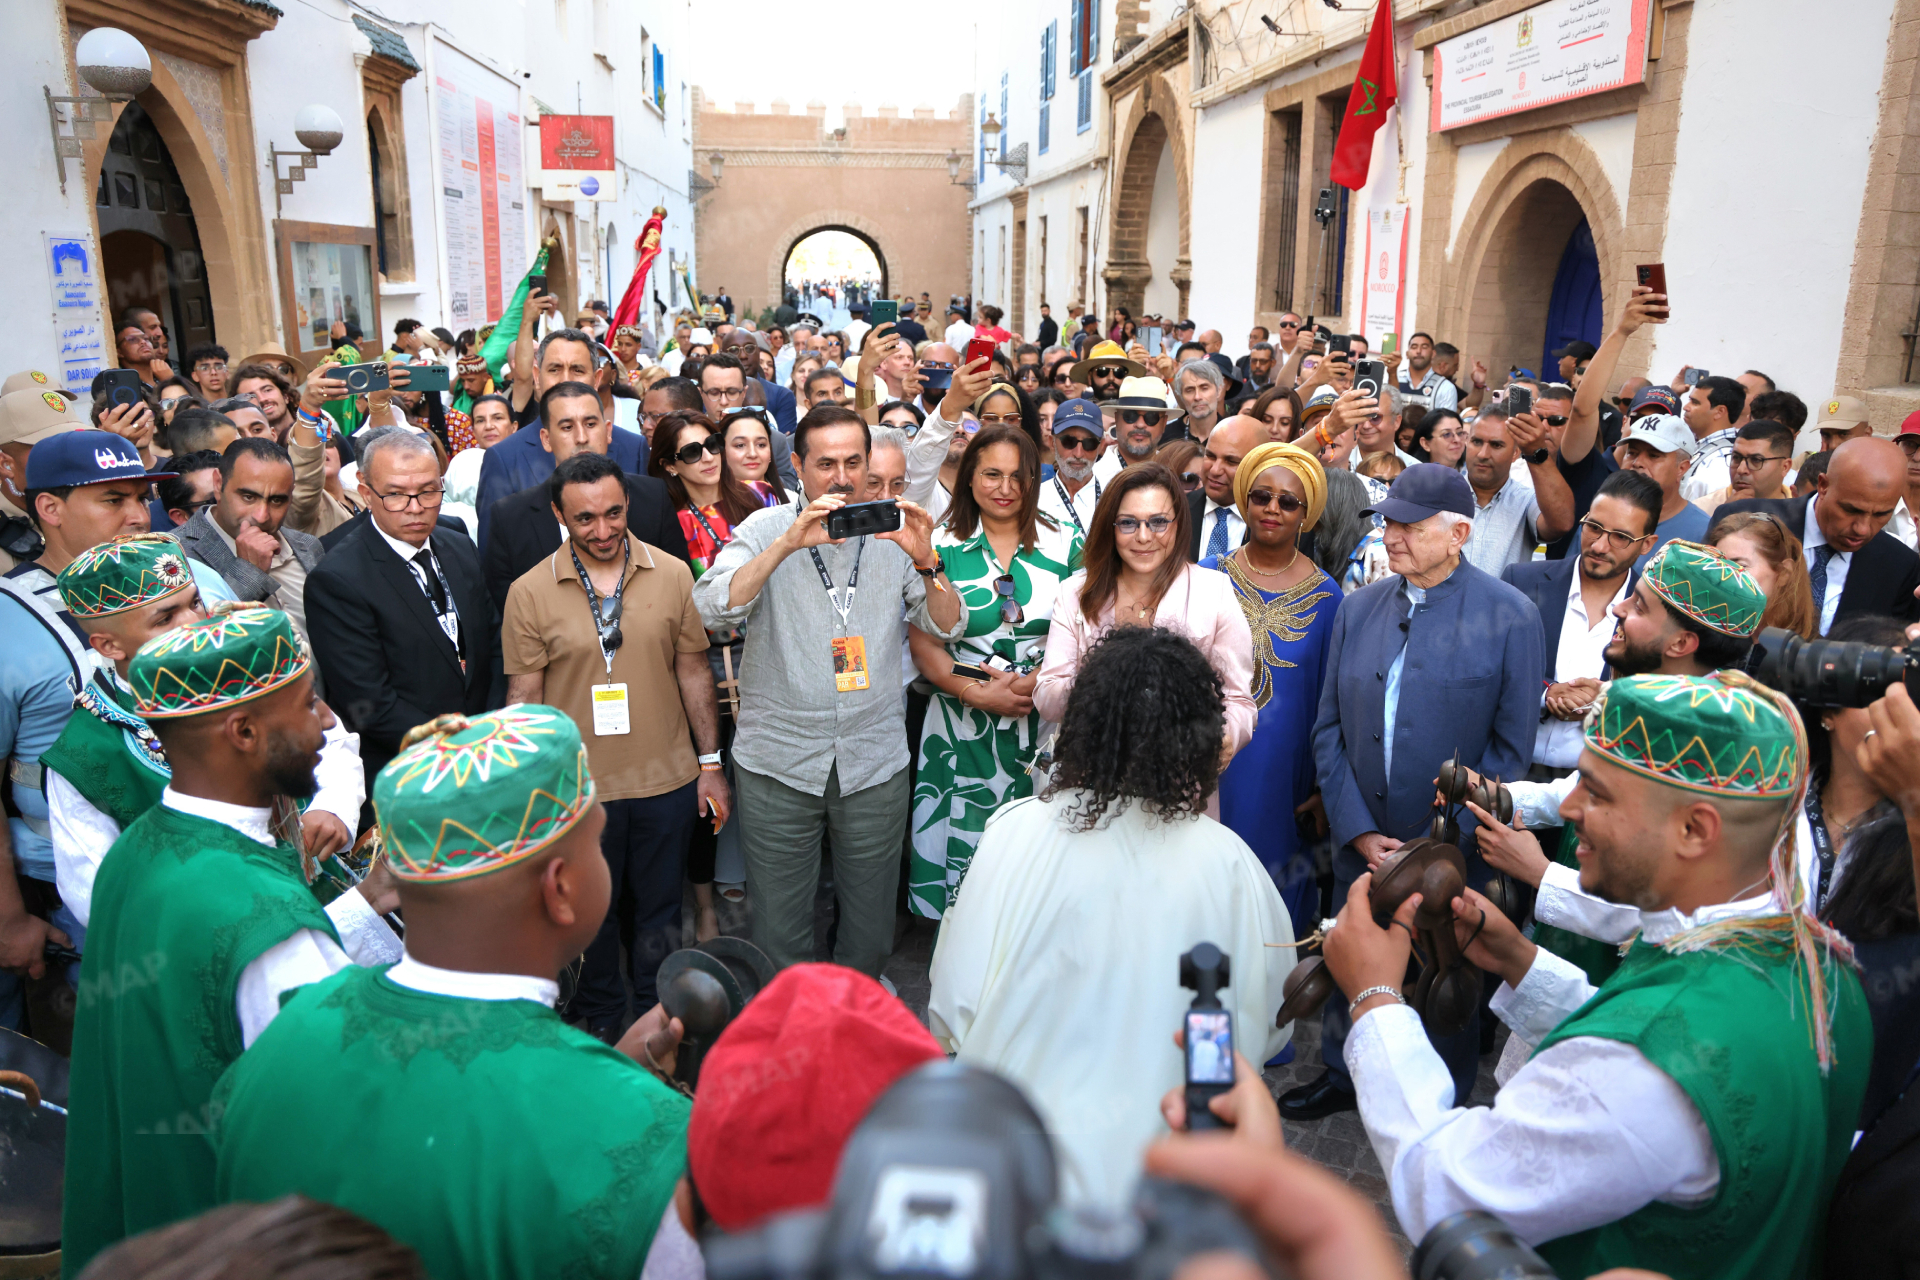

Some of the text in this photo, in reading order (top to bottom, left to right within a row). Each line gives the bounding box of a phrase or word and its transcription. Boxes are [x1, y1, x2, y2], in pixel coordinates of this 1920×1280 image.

[1468, 93, 1483, 104] TOURISM
[1482, 88, 1504, 100] DELEGATION
[1511, 90, 1532, 101] MOROCCO
[1463, 103, 1482, 114] ESSAOUIRA
[1370, 283, 1395, 293] MOROCCO
[67, 369, 80, 381] DAR
[1648, 388, 1676, 402] ORACLE
[1640, 416, 1661, 431] NY
